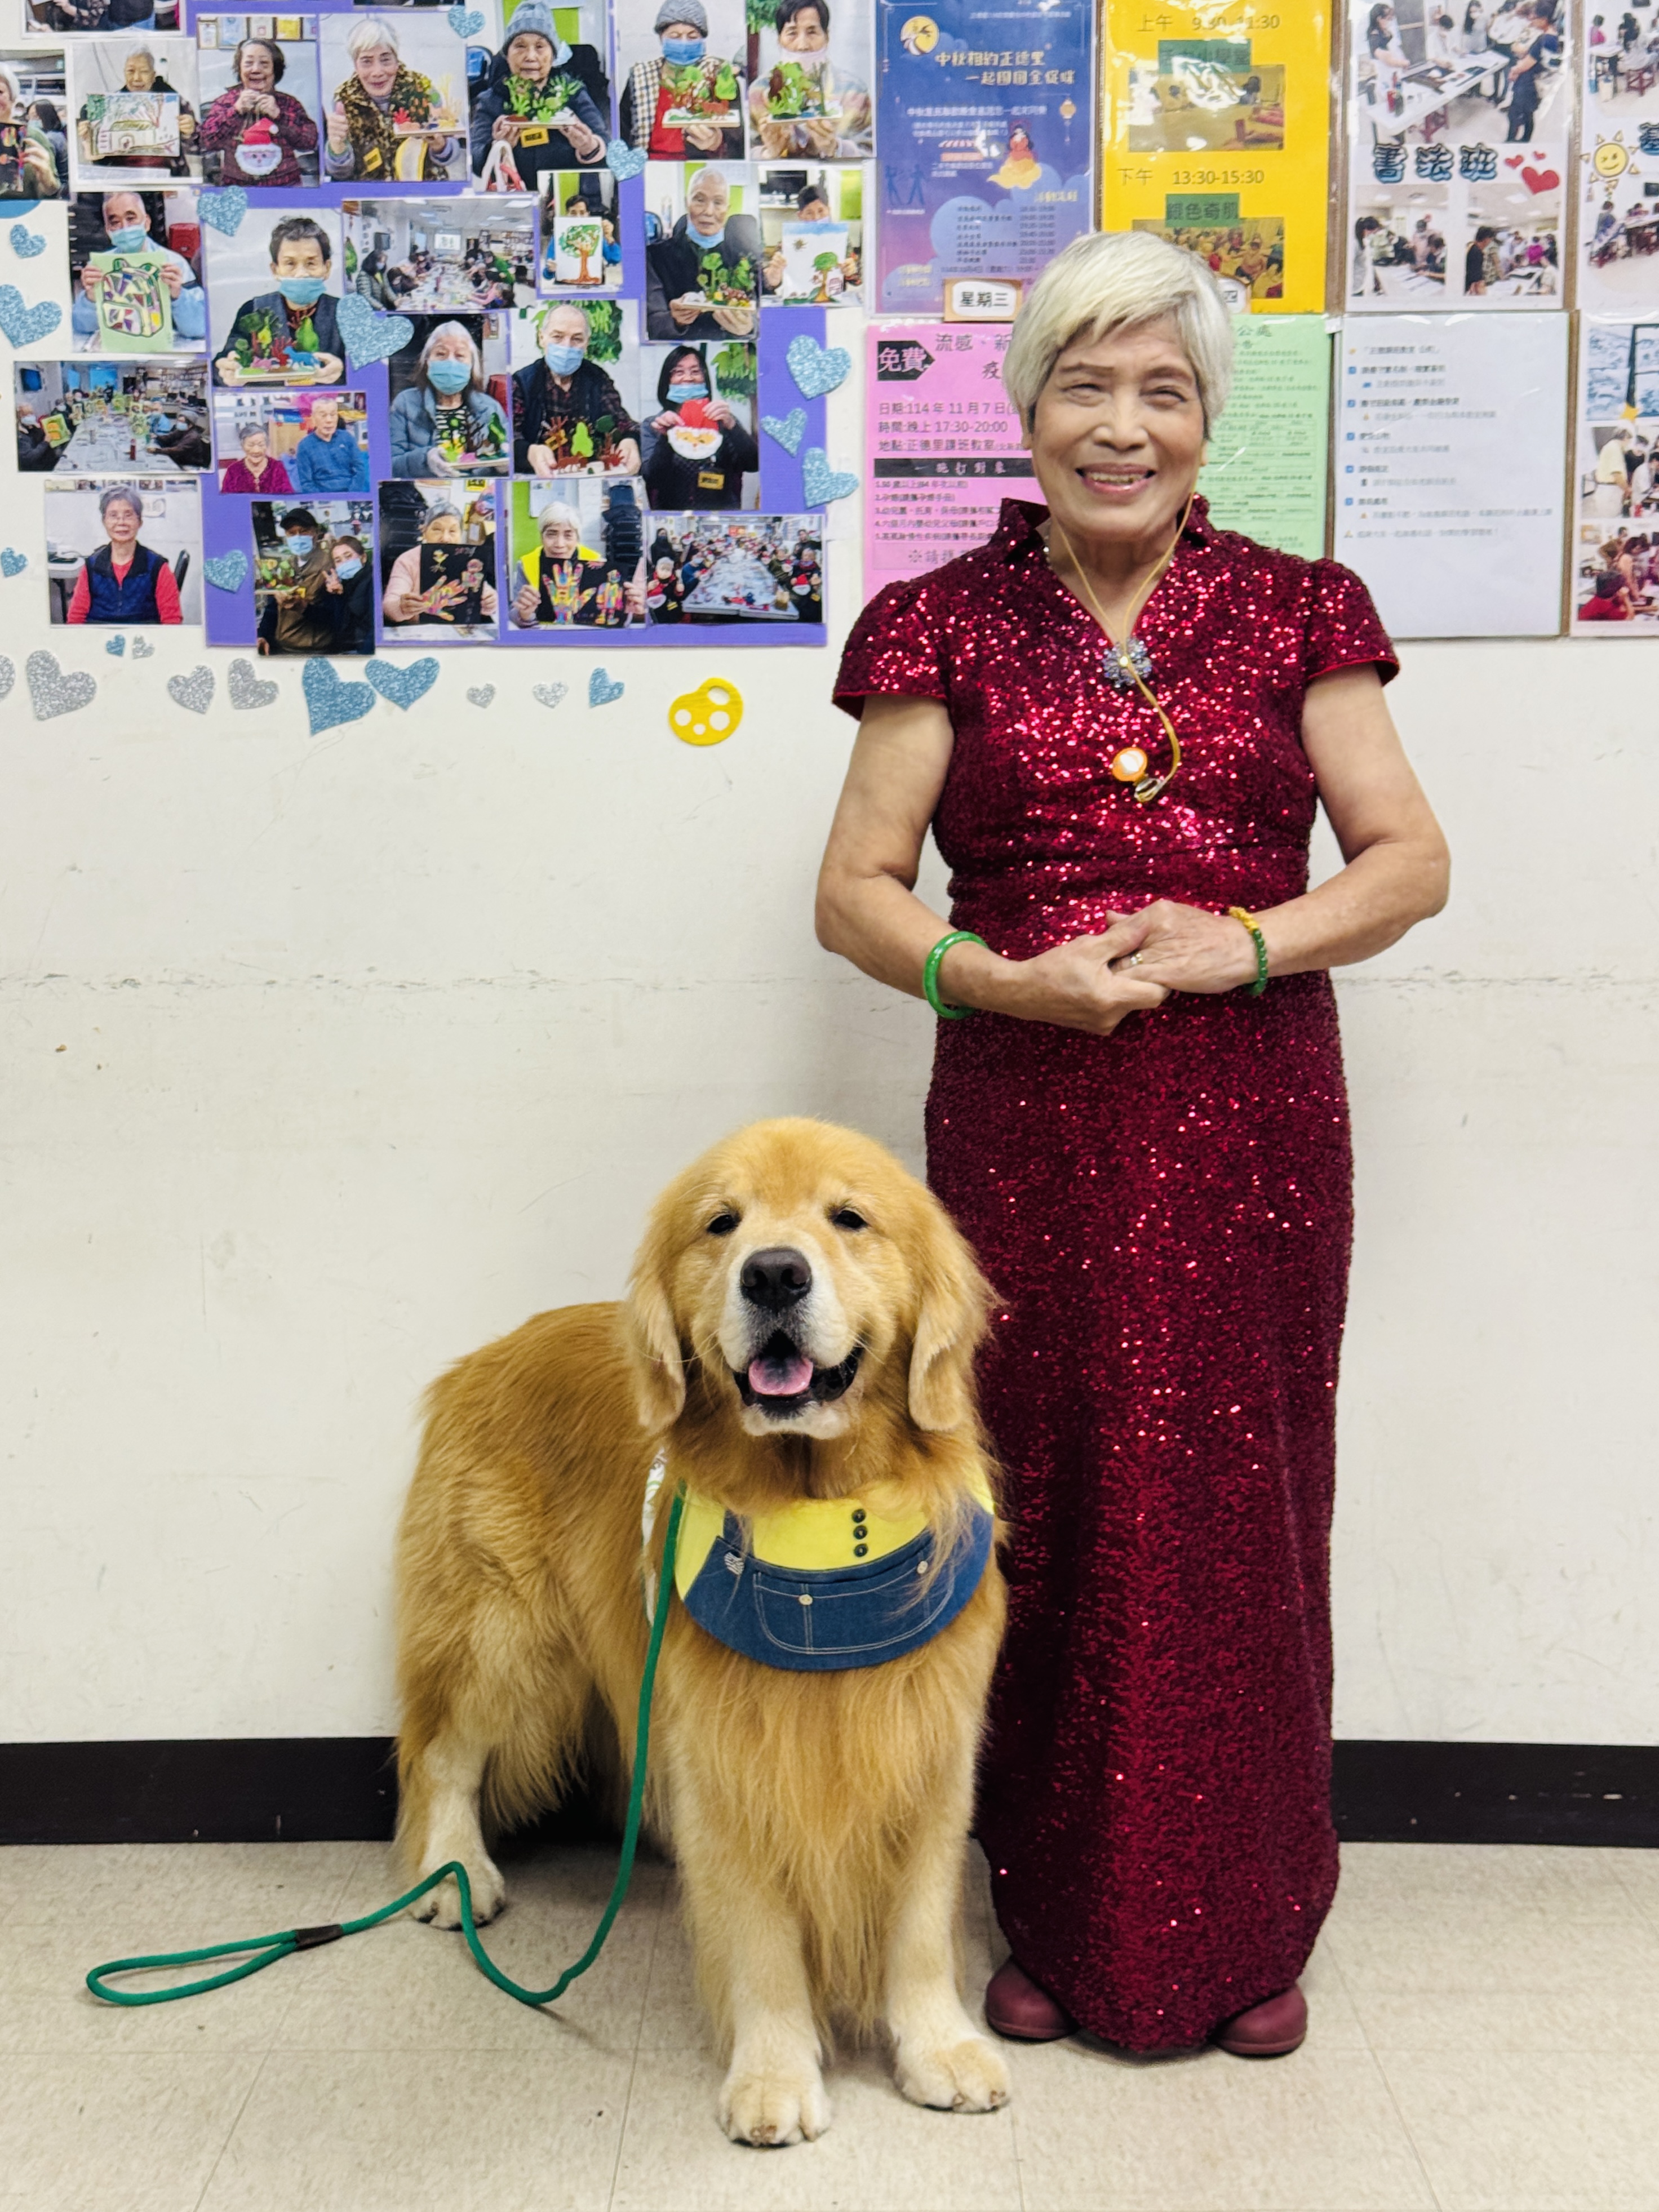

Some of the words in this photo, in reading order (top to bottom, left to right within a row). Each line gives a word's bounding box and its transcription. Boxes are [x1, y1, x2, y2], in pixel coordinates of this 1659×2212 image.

[1137, 14, 1173, 32] 上午
[1373, 142, 1498, 184] 書法班
[1117, 168, 1153, 186] 下午
[1172, 170, 1265, 185] 13:30-15:30
[960, 291, 1009, 308] 星期三
[878, 347, 928, 373] 免費
[935, 421, 1008, 434] 17:30-20:00
